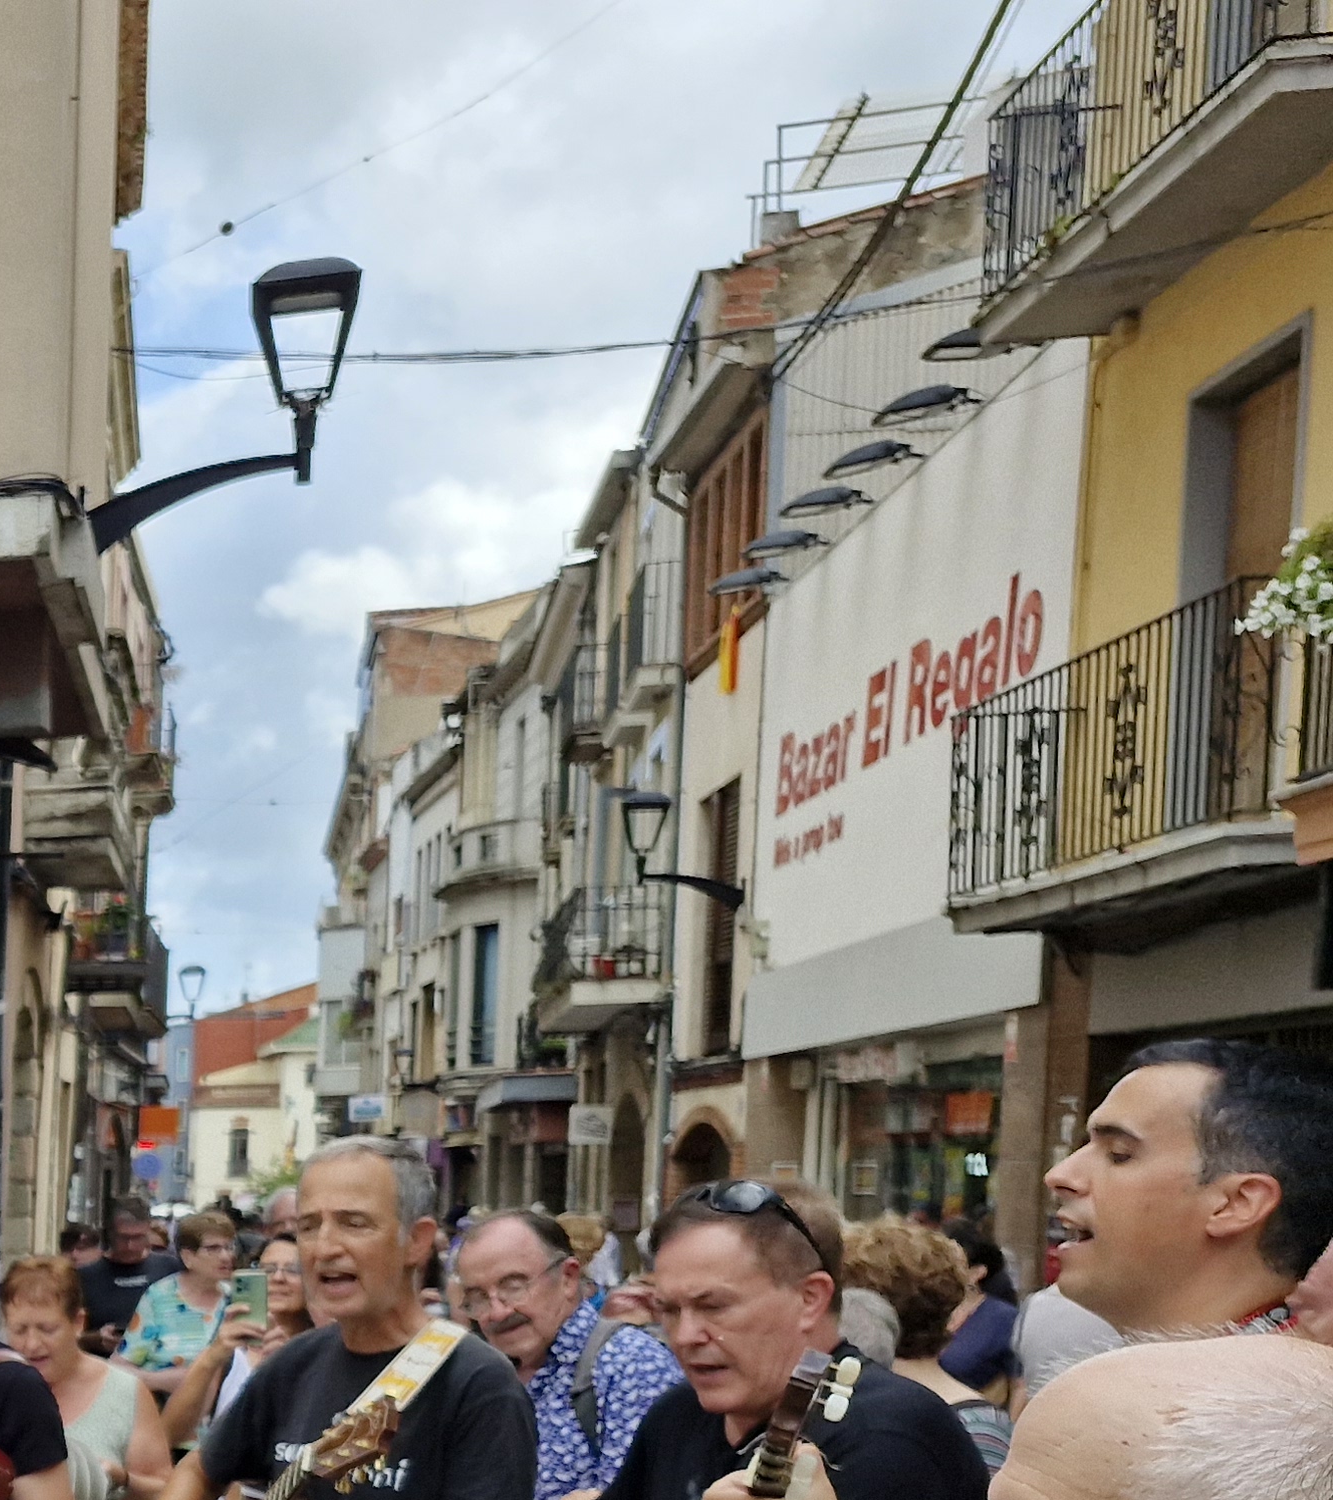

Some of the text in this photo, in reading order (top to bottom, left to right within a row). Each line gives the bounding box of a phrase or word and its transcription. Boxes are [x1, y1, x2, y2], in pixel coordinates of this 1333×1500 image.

[776, 572, 1044, 817] Bazar El Regalo
